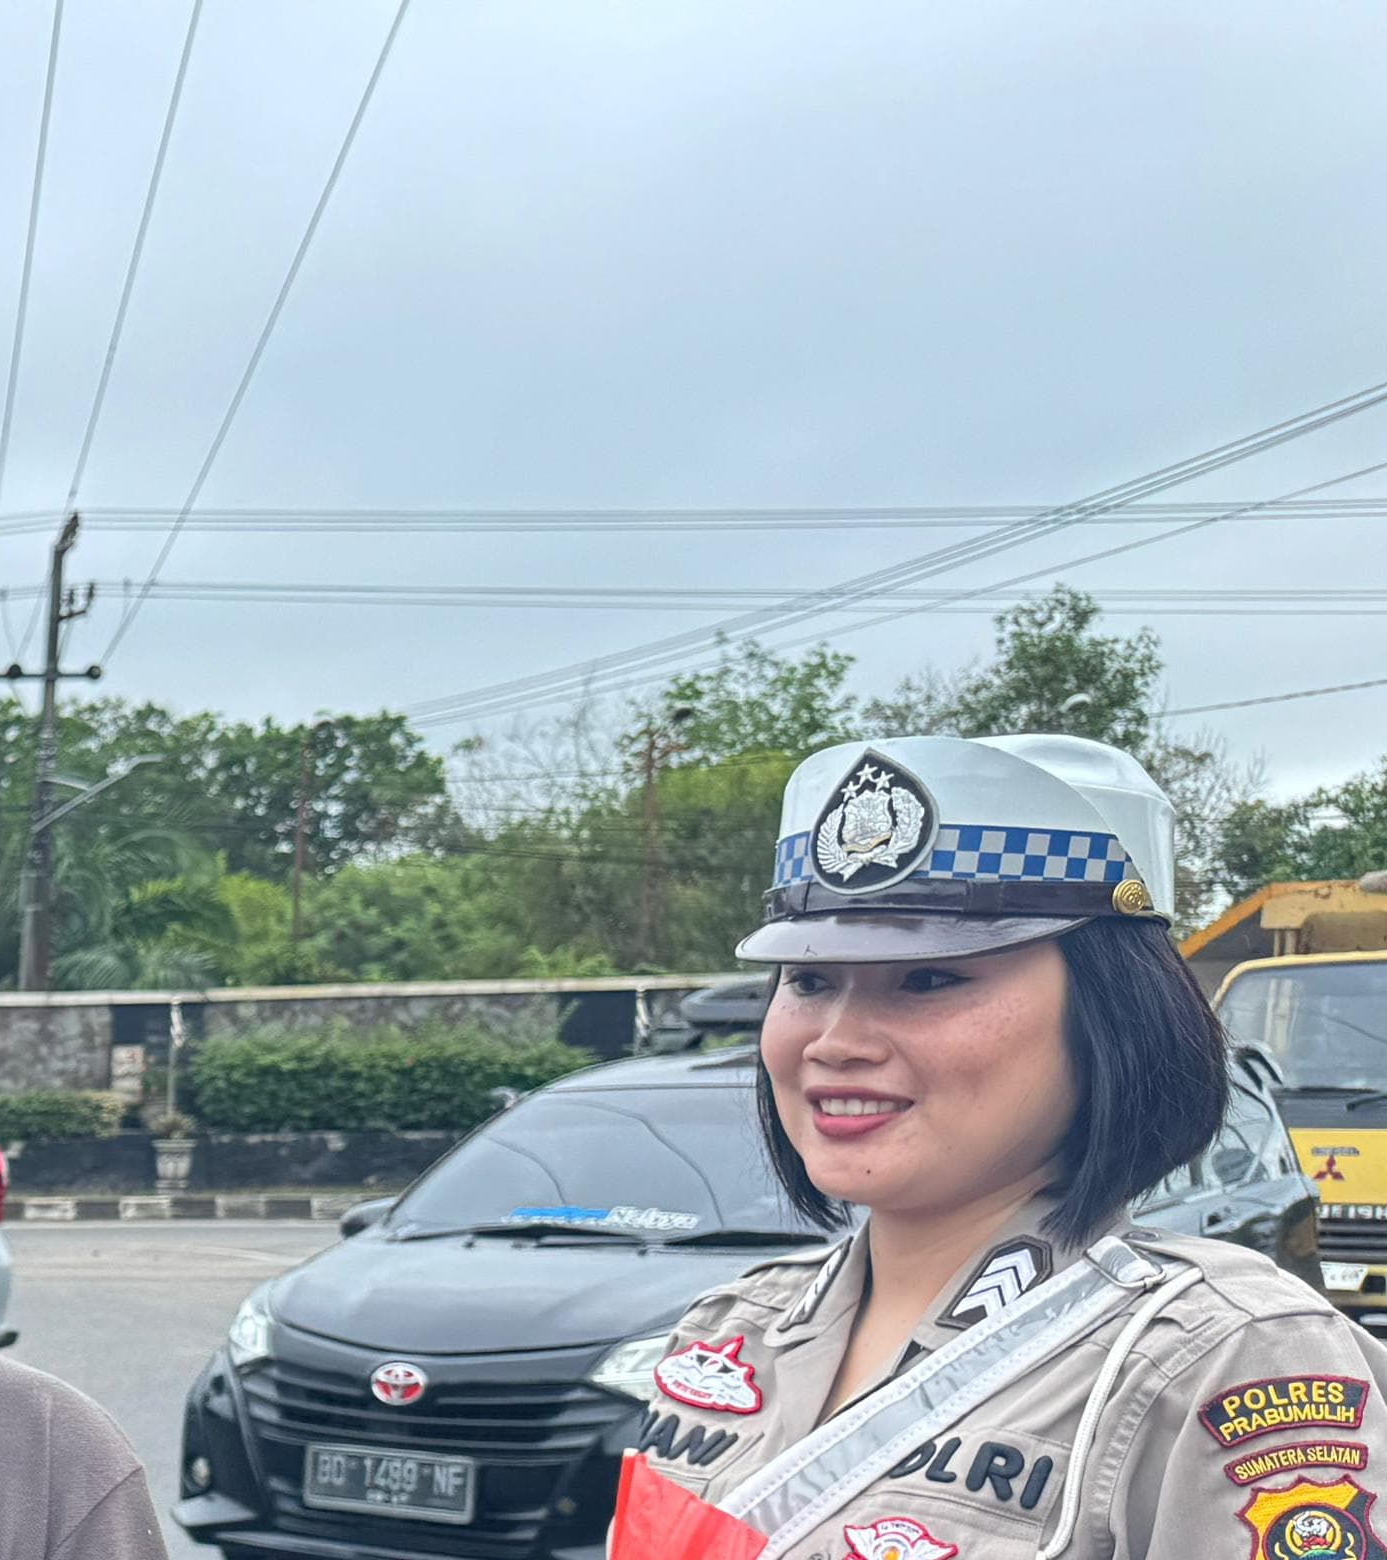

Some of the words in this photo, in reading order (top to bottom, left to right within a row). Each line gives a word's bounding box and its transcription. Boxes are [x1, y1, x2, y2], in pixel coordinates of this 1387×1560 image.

[1221, 1381, 1345, 1418] POLRES
[1219, 1404, 1355, 1441] PRABUMULIH
[1235, 1452, 1306, 1480] SUMATERA
[1307, 1447, 1361, 1465] SELATAN
